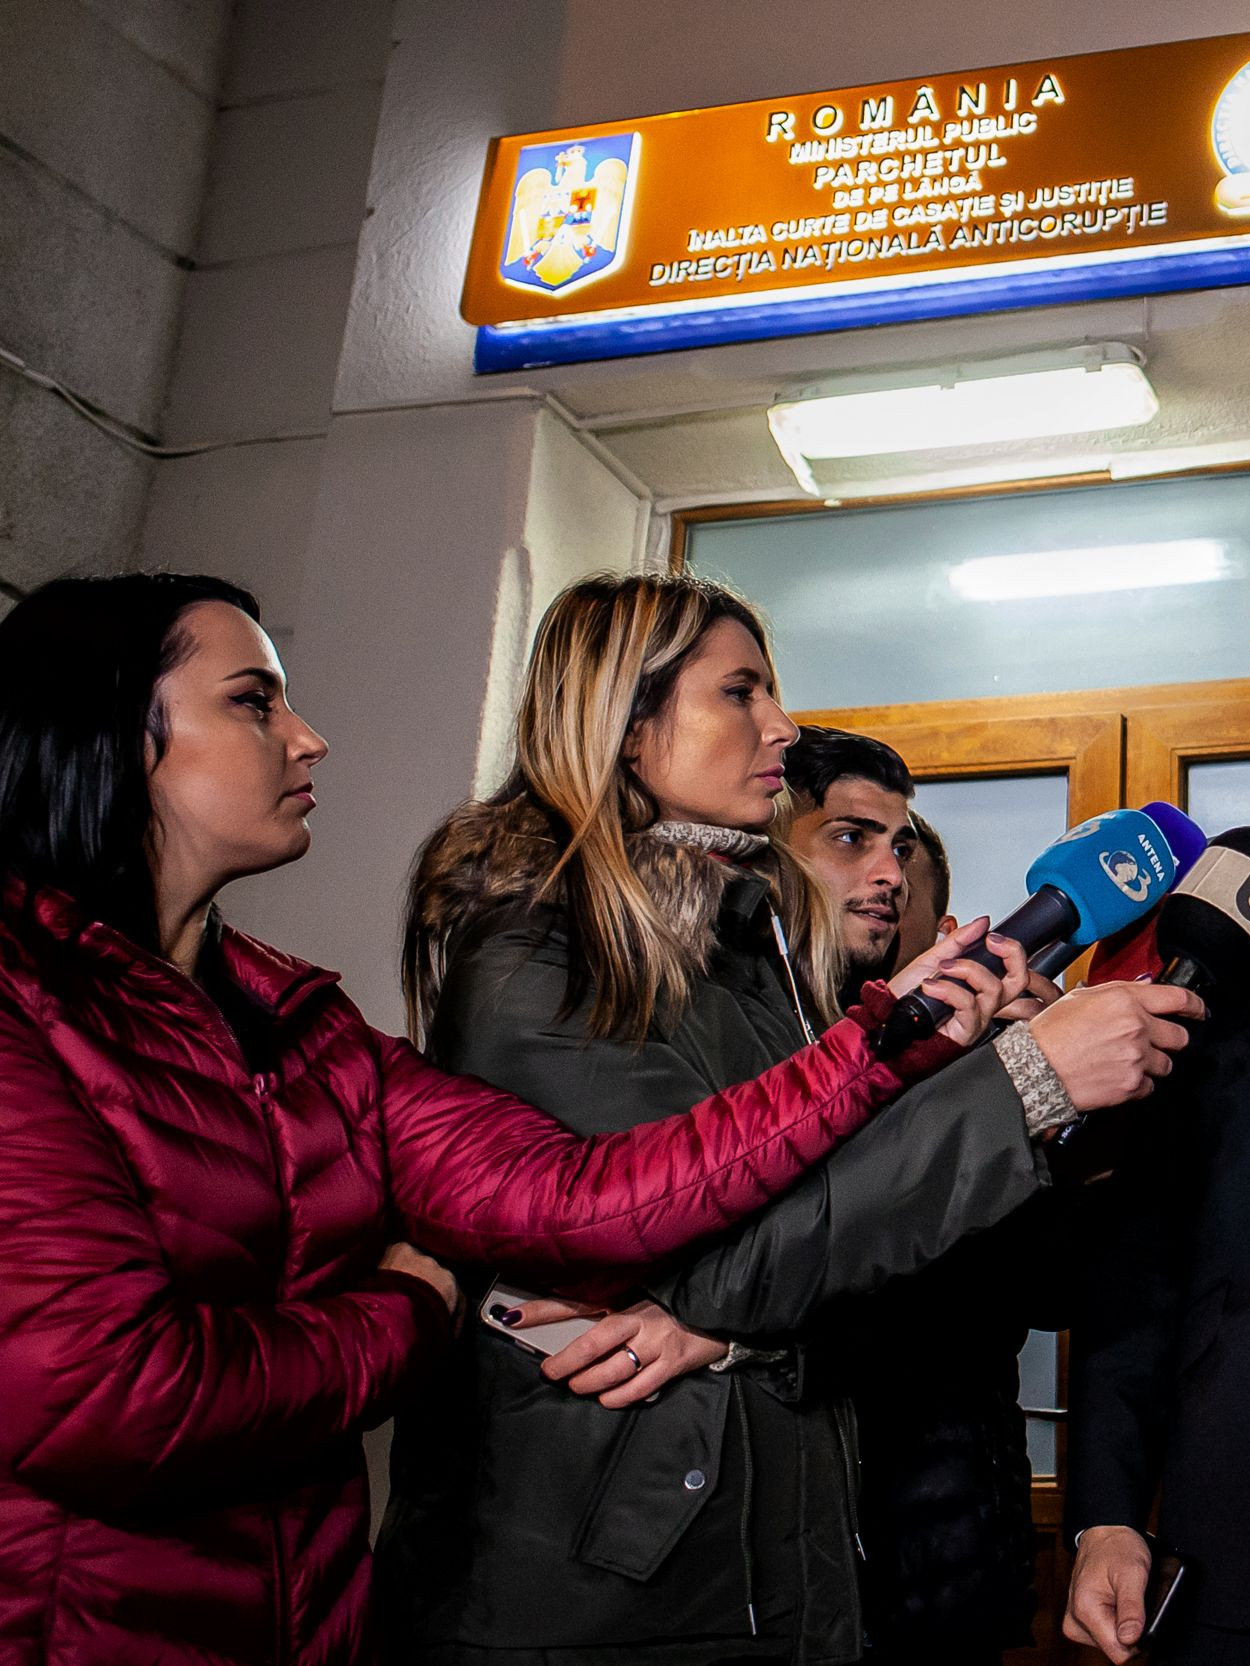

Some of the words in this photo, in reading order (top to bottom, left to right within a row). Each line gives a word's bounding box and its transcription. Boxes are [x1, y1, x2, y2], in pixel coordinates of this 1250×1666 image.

[765, 73, 1065, 143] ROMÂNIA
[788, 125, 940, 165] MINISTERUL
[943, 112, 1038, 146] PUBLIC
[813, 143, 1008, 190] PARCHETUL
[832, 188, 865, 209] DE
[868, 182, 899, 205] PE
[770, 212, 851, 243] CURTE
[854, 207, 889, 232] DE
[1137, 833, 1165, 882] ANTENA
